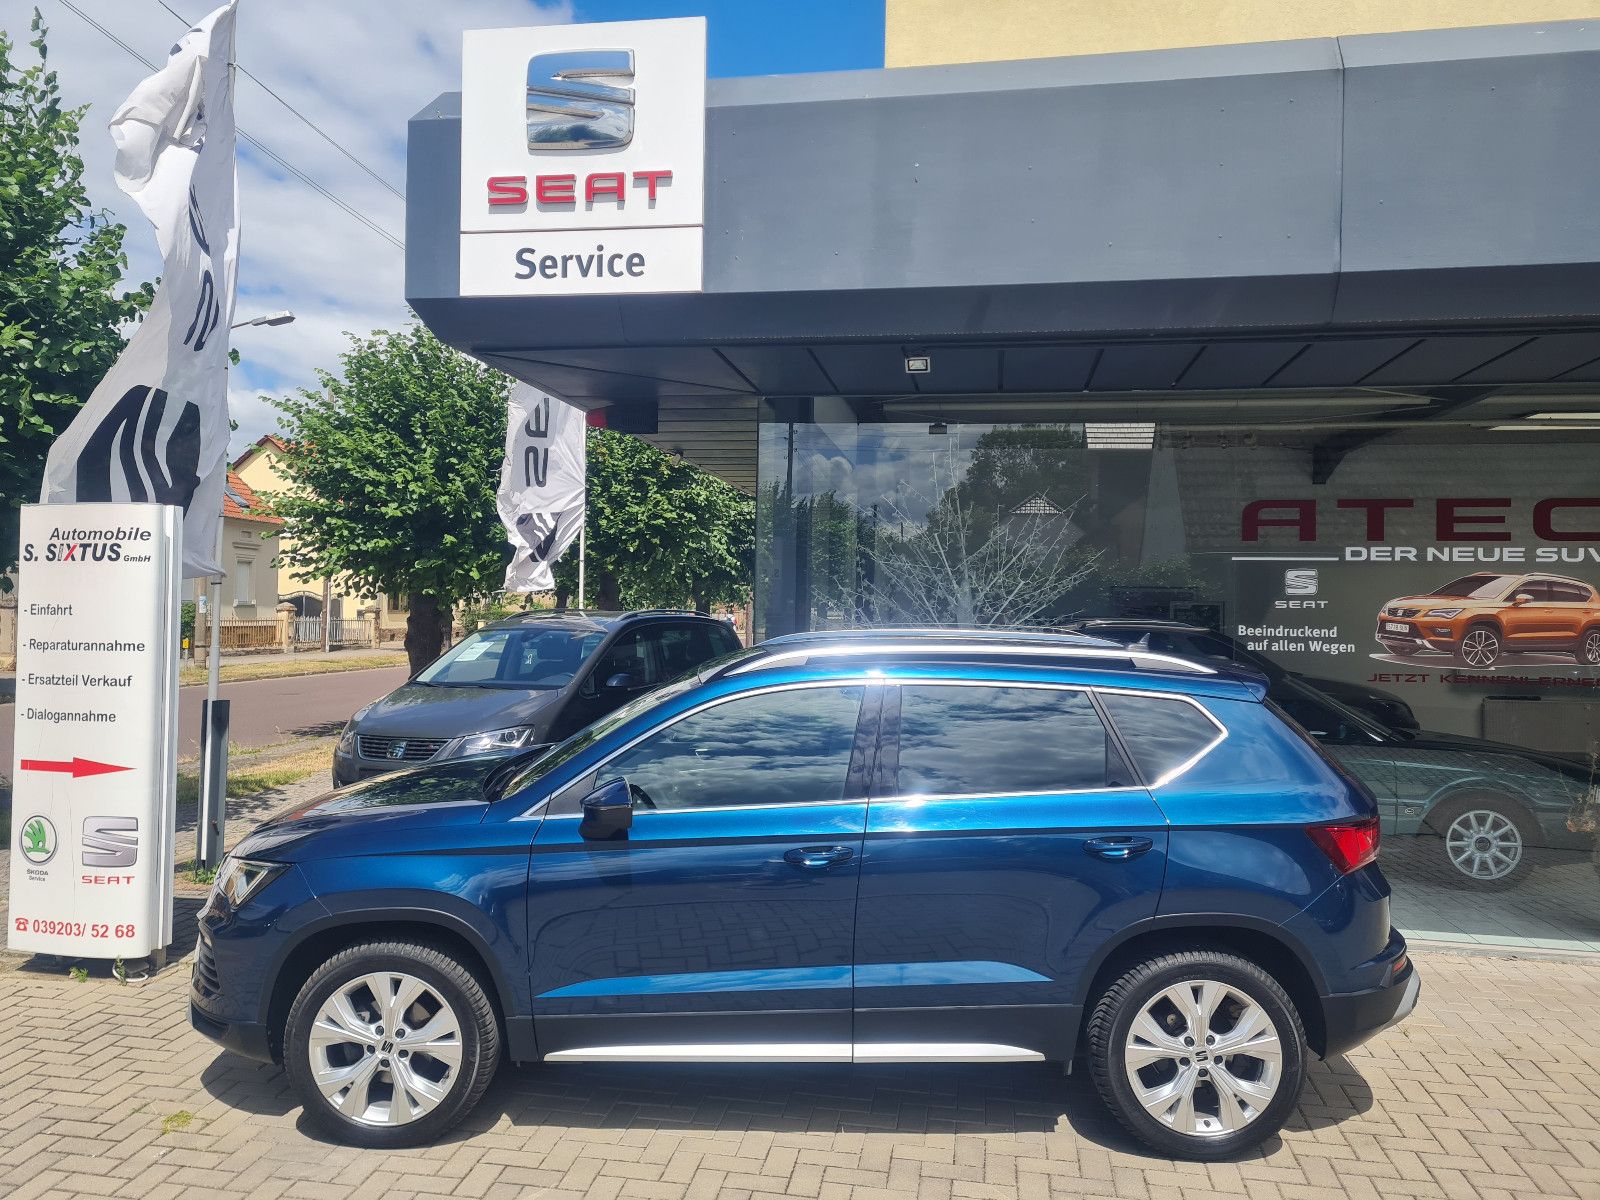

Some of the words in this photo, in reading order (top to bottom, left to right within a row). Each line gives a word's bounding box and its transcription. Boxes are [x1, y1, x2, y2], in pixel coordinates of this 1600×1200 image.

[487, 170, 673, 206] SEAT
[514, 244, 646, 280] Service
[49, 527, 152, 541] Automobile
[23, 543, 39, 562] S.
[46, 543, 122, 562] SIXTUS
[123, 554, 152, 563] GmbH
[1345, 546, 1418, 562] DER
[1426, 547, 1526, 562] NEUE
[30, 604, 73, 616] Einfahrt
[1274, 600, 1329, 609] SEAT
[1238, 624, 1338, 638] Beeindruckend
[29, 638, 146, 652] Reparaturannahme
[1247, 639, 1269, 651] auf
[1271, 639, 1305, 652] allen
[1308, 640, 1356, 655] Wegen
[28, 673, 79, 686] Ersatzteil
[81, 675, 133, 688] Verkauf
[1367, 673, 1430, 683] JETZT
[26, 708, 117, 723] Dialogannahme
[81, 875, 136, 885] SEAT
[32, 919, 87, 937] 039203/
[91, 924, 109, 938] 52
[115, 924, 136, 938] 68
